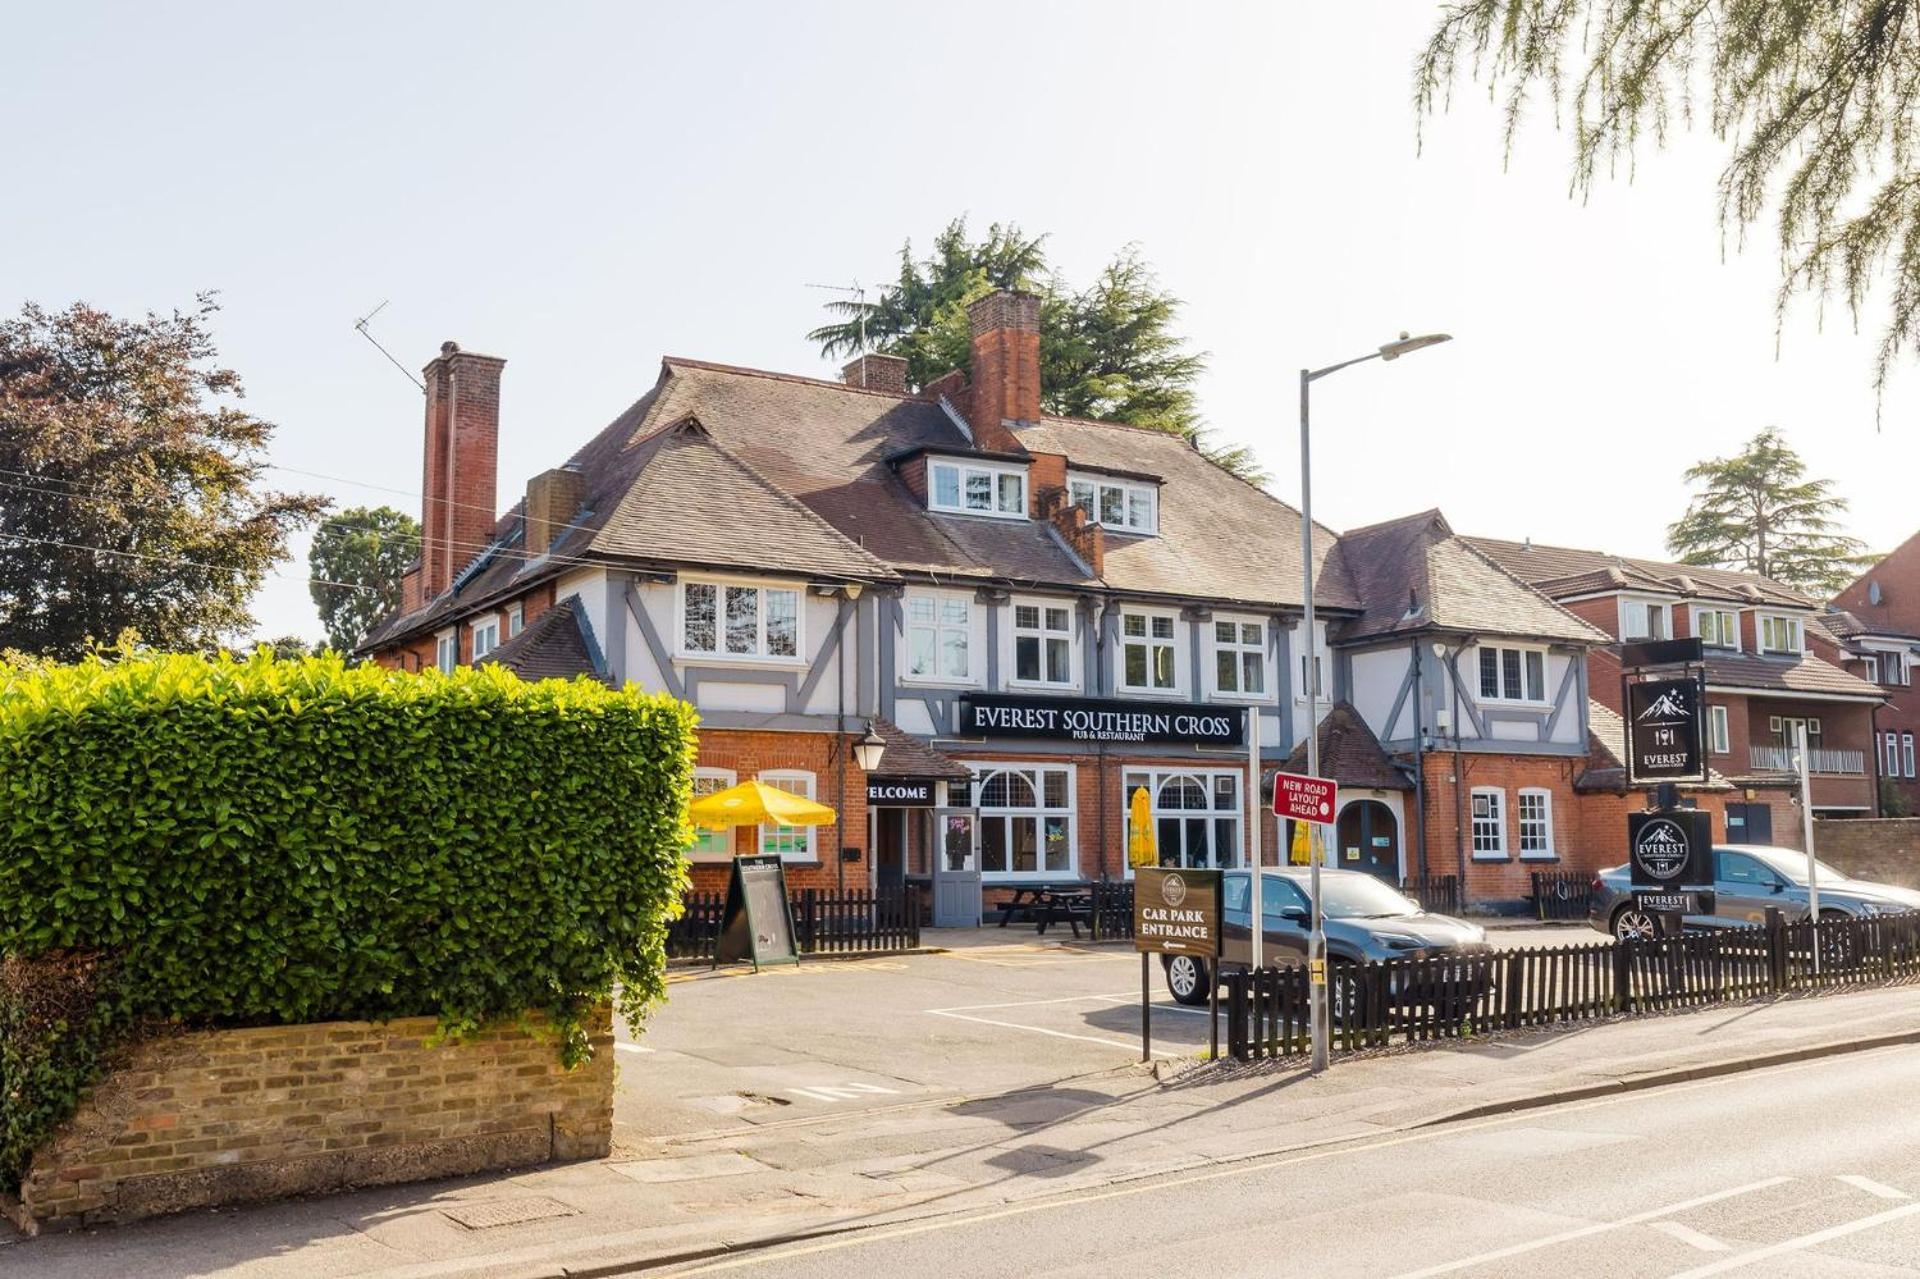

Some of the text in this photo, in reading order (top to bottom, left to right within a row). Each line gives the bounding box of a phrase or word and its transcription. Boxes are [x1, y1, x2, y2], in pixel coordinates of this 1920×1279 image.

[974, 706, 1230, 736] EVEREST SOUTHERN CROSS
[1072, 730, 1146, 741] PUB & RESTAURANT
[1644, 753, 1688, 765] EVEREST
[866, 786, 927, 799] ELCOME
[1283, 779, 1328, 796] NEW ROAD
[1289, 791, 1320, 806] LAYOUT
[1290, 802, 1318, 817] AHEAD
[1639, 843, 1685, 854] EVEREST
[1643, 895, 1685, 905] EVEREST
[1142, 907, 1204, 923] CAR PARK
[1141, 922, 1208, 939] ENTRANCE
